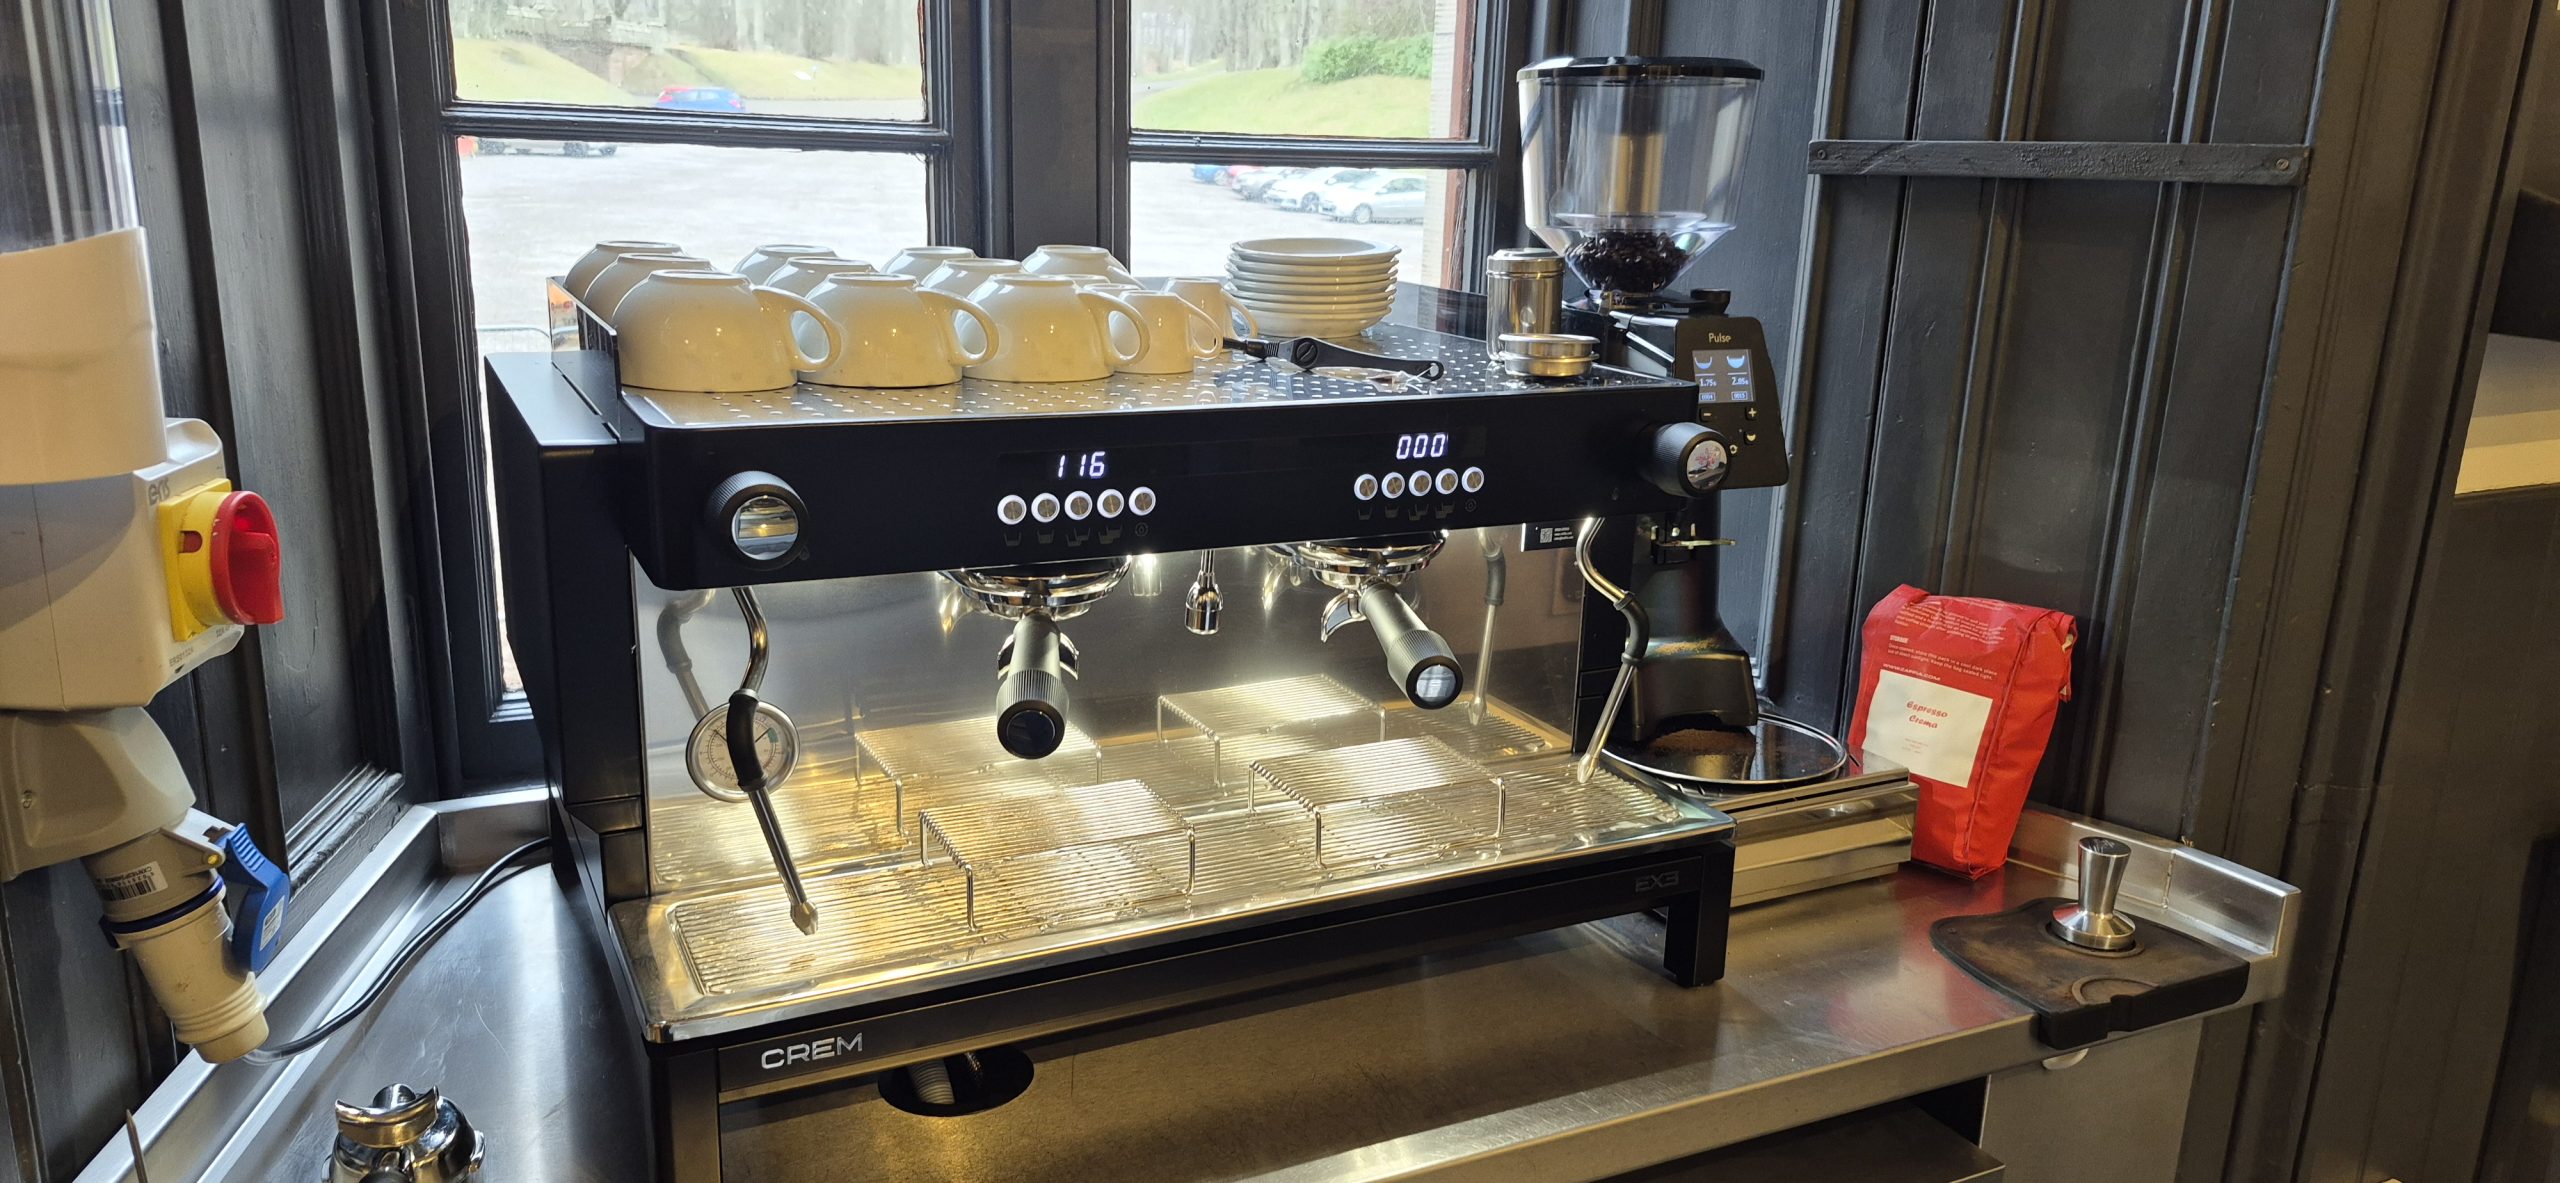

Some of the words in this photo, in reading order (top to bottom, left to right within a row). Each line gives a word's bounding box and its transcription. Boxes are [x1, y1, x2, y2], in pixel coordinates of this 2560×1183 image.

[1708, 332, 1731, 343] Pulse
[1396, 433, 1446, 460] 000
[1057, 451, 1106, 478] 116
[1906, 700, 1948, 718] Espresso
[1909, 714, 1938, 729] Crema
[761, 1032, 863, 1069] CREM
